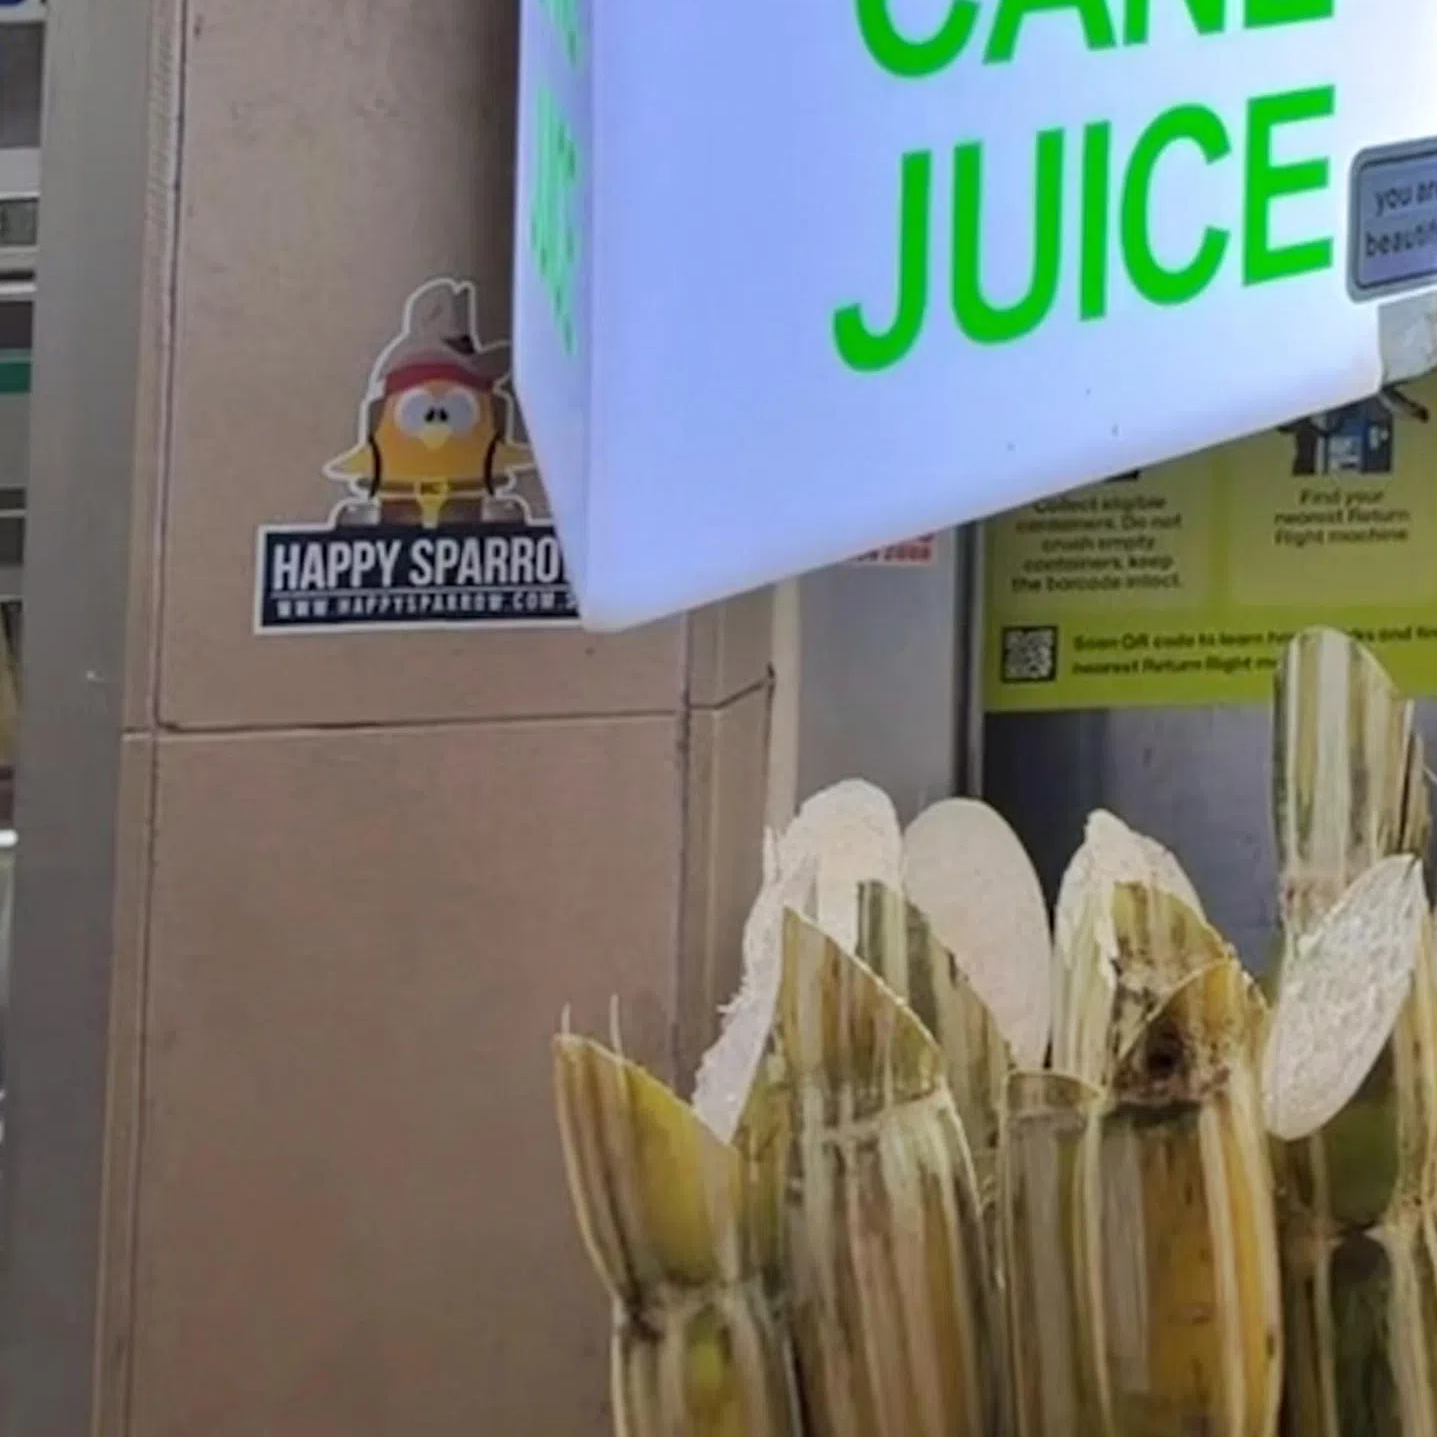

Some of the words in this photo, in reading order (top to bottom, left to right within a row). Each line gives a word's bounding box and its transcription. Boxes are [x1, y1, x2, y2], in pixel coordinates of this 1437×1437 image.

[1374, 185, 1413, 217] you
[832, 83, 1336, 373] JUICE
[1300, 488, 1341, 505] Find
[1345, 490, 1385, 506] your
[273, 539, 401, 590] HAPPY
[409, 536, 567, 587] SPARRO
